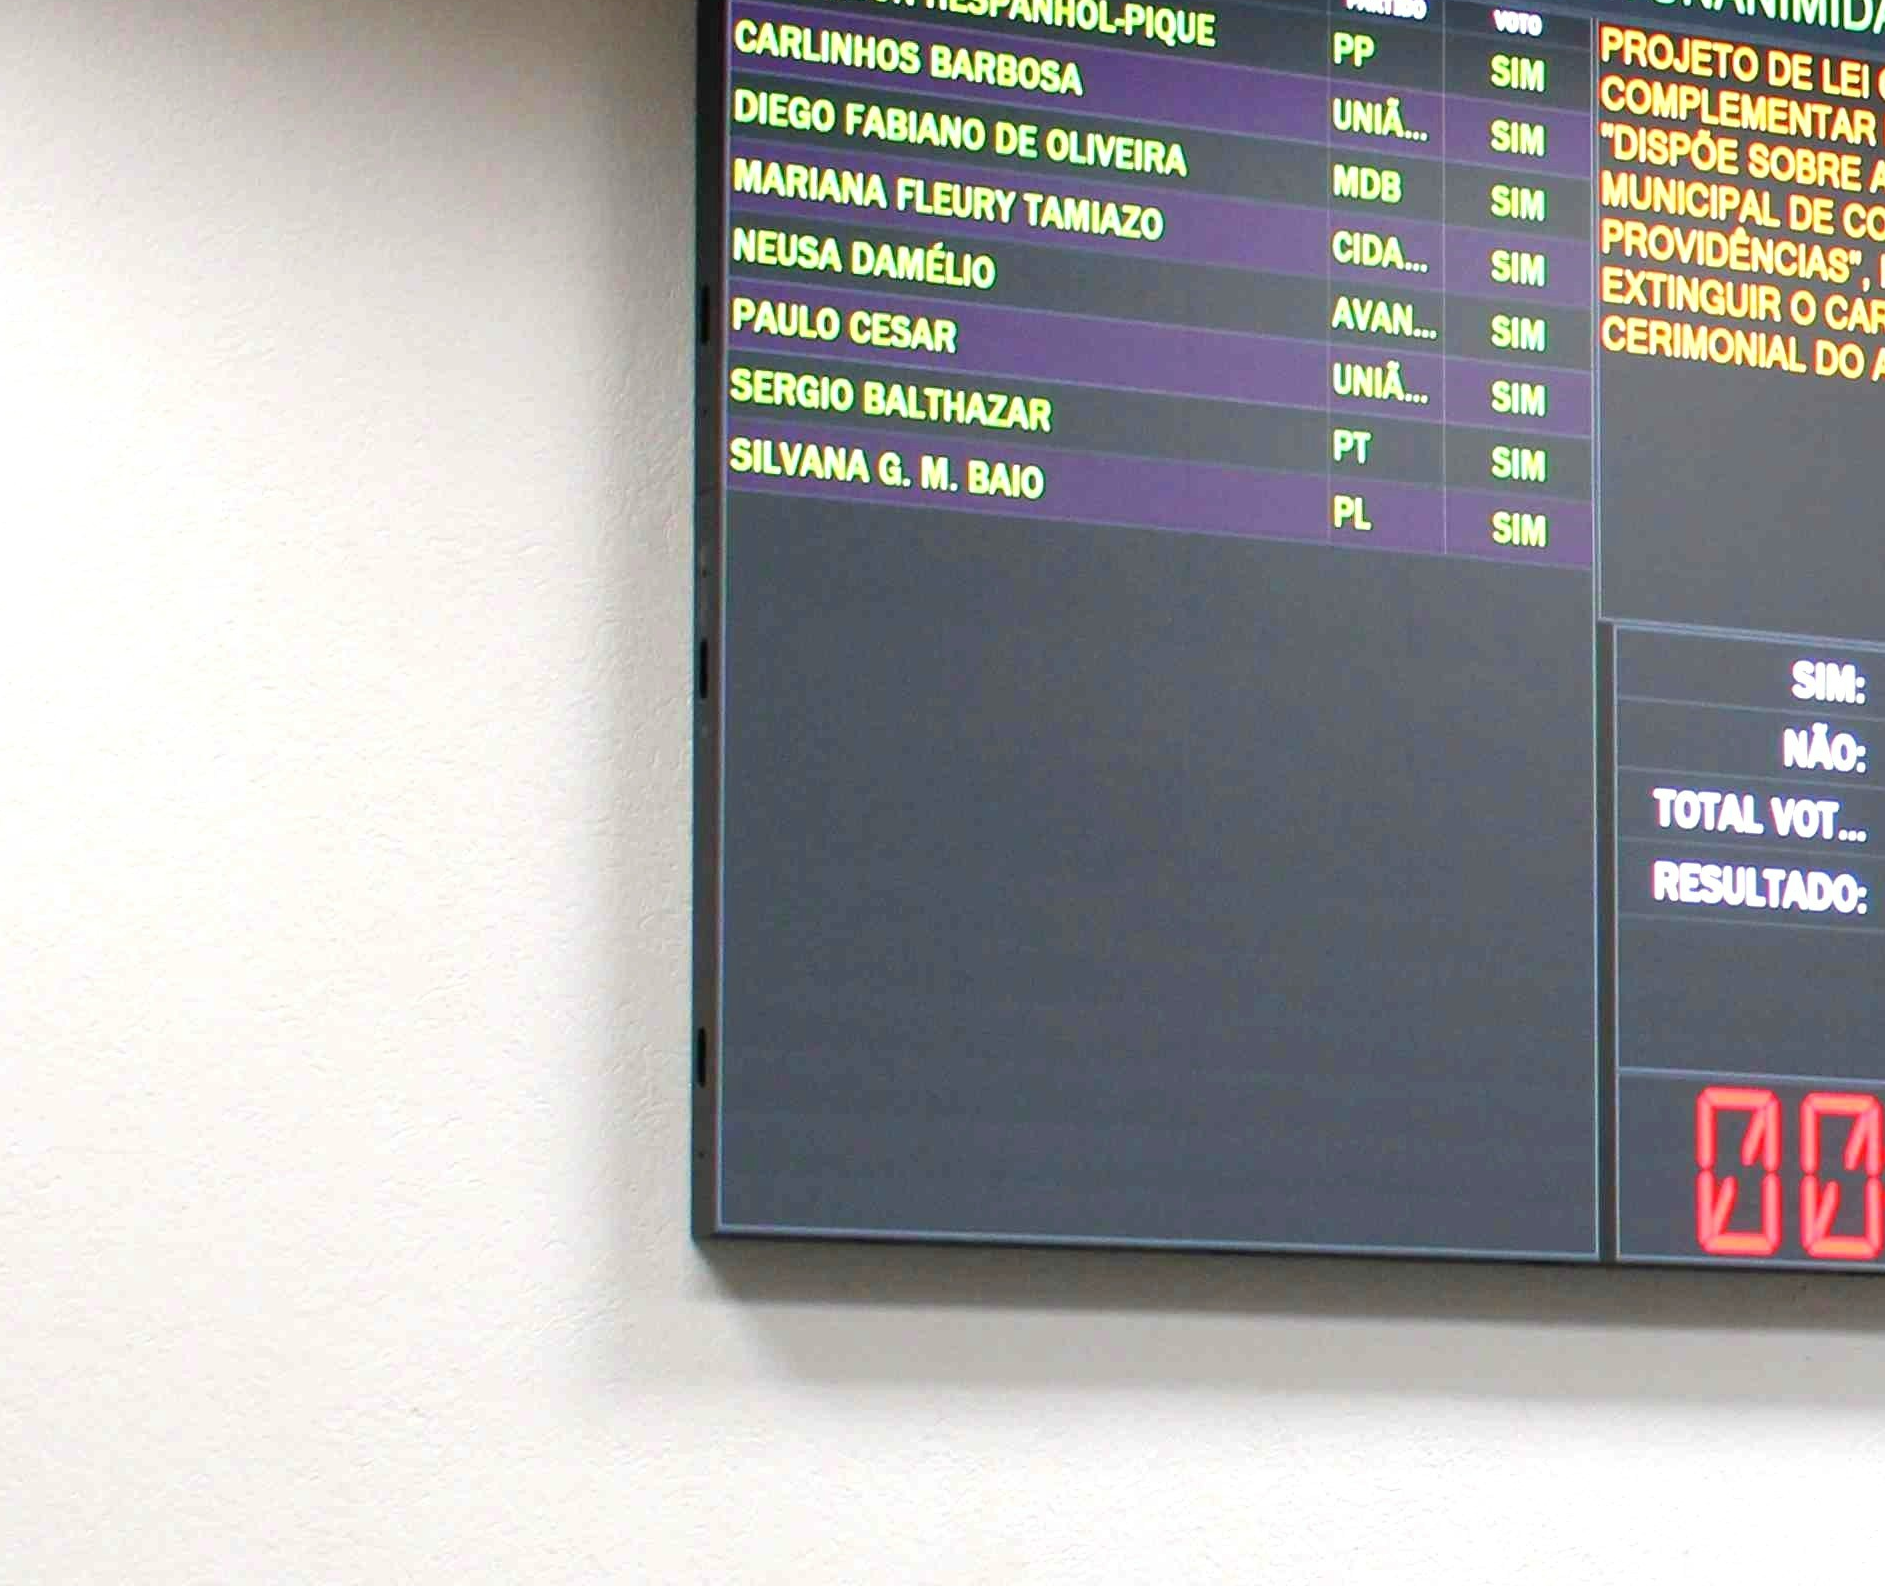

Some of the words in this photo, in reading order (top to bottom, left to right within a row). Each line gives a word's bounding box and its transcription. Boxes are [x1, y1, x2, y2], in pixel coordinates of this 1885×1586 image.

[1493, 10, 1542, 36] VOTO
[735, 20, 921, 73] CARLINHOS
[931, 45, 1082, 95] BARBOSA
[1334, 32, 1374, 66] PP
[1492, 55, 1544, 91] SIM
[1602, 27, 1759, 82] PROJETO
[1769, 51, 1813, 90] DE
[1823, 59, 1869, 99] LEI
[735, 89, 835, 132] DIEGO
[846, 103, 985, 150] FABIANO
[996, 122, 1037, 158] DE
[1046, 129, 1187, 176] OLIVEIRA
[1601, 75, 1877, 146] COMPLEMENTAR
[1491, 120, 1544, 156] SIM
[1601, 122, 1739, 175] "DISPÕE
[1748, 143, 1862, 192] SOBRE
[734, 158, 887, 208] MARIANA
[897, 178, 1016, 222] FLEURY
[1023, 193, 1163, 240] TAMIAZO
[1334, 164, 1401, 203] MDB
[1491, 185, 1545, 221] SIM
[1602, 170, 1781, 228] MUNICIPAL
[1790, 195, 1834, 235] DE
[734, 228, 842, 272] NEUSA
[852, 242, 995, 288] DAMÉLIO
[1491, 250, 1545, 286] SIM
[1601, 218, 1870, 292] PROVIDÊNCIAS",
[1602, 266, 1782, 322] EXTINGUIR
[1790, 290, 1820, 326] O
[733, 298, 840, 340] PAULO
[849, 311, 956, 353] CESAR
[1491, 315, 1545, 351] SIM
[1602, 315, 1808, 373] CERIMONIAL
[1815, 339, 1865, 379] DO
[730, 368, 853, 411] SERGIO
[864, 381, 1051, 432] BALTHAZAR
[1492, 381, 1545, 416] SIM
[729, 438, 870, 482] SILVANA
[878, 452, 910, 486] G.
[921, 456, 957, 491] M.
[968, 460, 1043, 498] BAIO
[1334, 430, 1371, 463] PT
[1492, 446, 1545, 482] SIM
[1334, 495, 1371, 530] PL
[1492, 511, 1546, 547] SIM
[1791, 658, 1865, 704] SIM:
[1783, 722, 1866, 773] NÃO:
[1652, 786, 1764, 834] TOTAL
[1652, 859, 1867, 914] RESULTADO:
